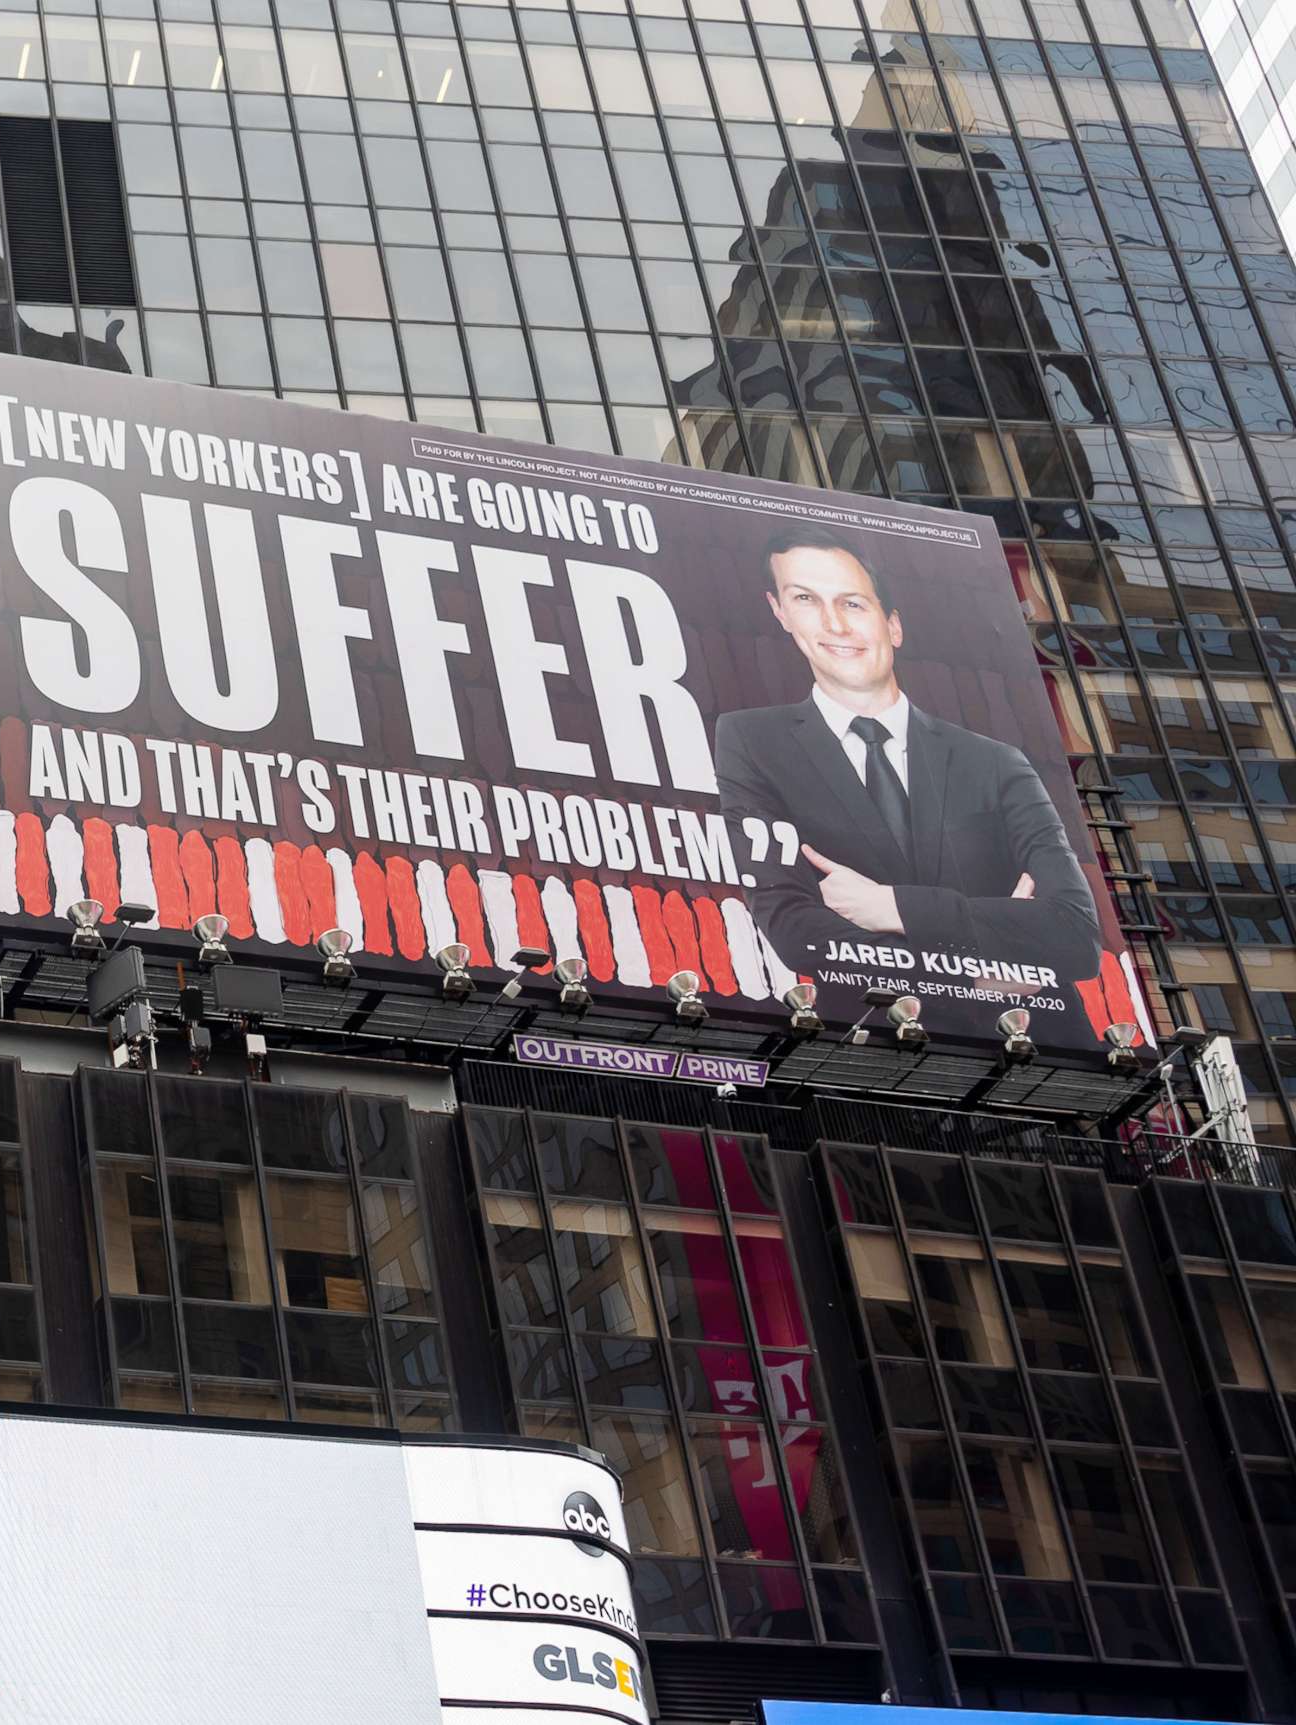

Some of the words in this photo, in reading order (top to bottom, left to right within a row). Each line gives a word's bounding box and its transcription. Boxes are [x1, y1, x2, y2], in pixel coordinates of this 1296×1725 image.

[135, 424, 372, 521] YORKERS]
[382, 464, 464, 525] ARE
[466, 477, 601, 550] GOING
[602, 499, 659, 554] TO
[421, 445, 442, 456] PAID
[443, 447, 463, 459] FOR
[463, 451, 475, 462] BY
[476, 453, 495, 465] THE
[495, 457, 536, 471] LINCOLN
[536, 463, 579, 478] PROJECT.
[579, 471, 599, 482] NOT
[600, 474, 655, 490] AUTHORIZED
[656, 482, 668, 492] BY
[669, 485, 688, 497] ANY
[689, 487, 737, 502] CANDIDATE
[737, 494, 752, 505] OR
[753, 497, 808, 515] CANDIDATE'S
[809, 506, 861, 523] COMMITTEE.
[862, 517, 972, 542] WWW.LINCOLNPROJECT.US
[9, 477, 720, 794] SUFFER
[29, 724, 141, 808] AND
[336, 764, 492, 854] THEIR
[825, 940, 916, 969] JARED
[921, 951, 1059, 988] KUSHNER
[818, 969, 873, 987] VANITY
[877, 977, 915, 994] FAIR,
[917, 981, 1005, 1004] SEPTEMBER
[1007, 993, 1025, 1007] 17,
[1026, 996, 1065, 1012] 2020
[522, 1040, 670, 1073] OUTFRONT
[687, 1058, 762, 1082] PRIME
[564, 1504, 610, 1539] abc
[466, 1583, 638, 1632] #ChooseKind
